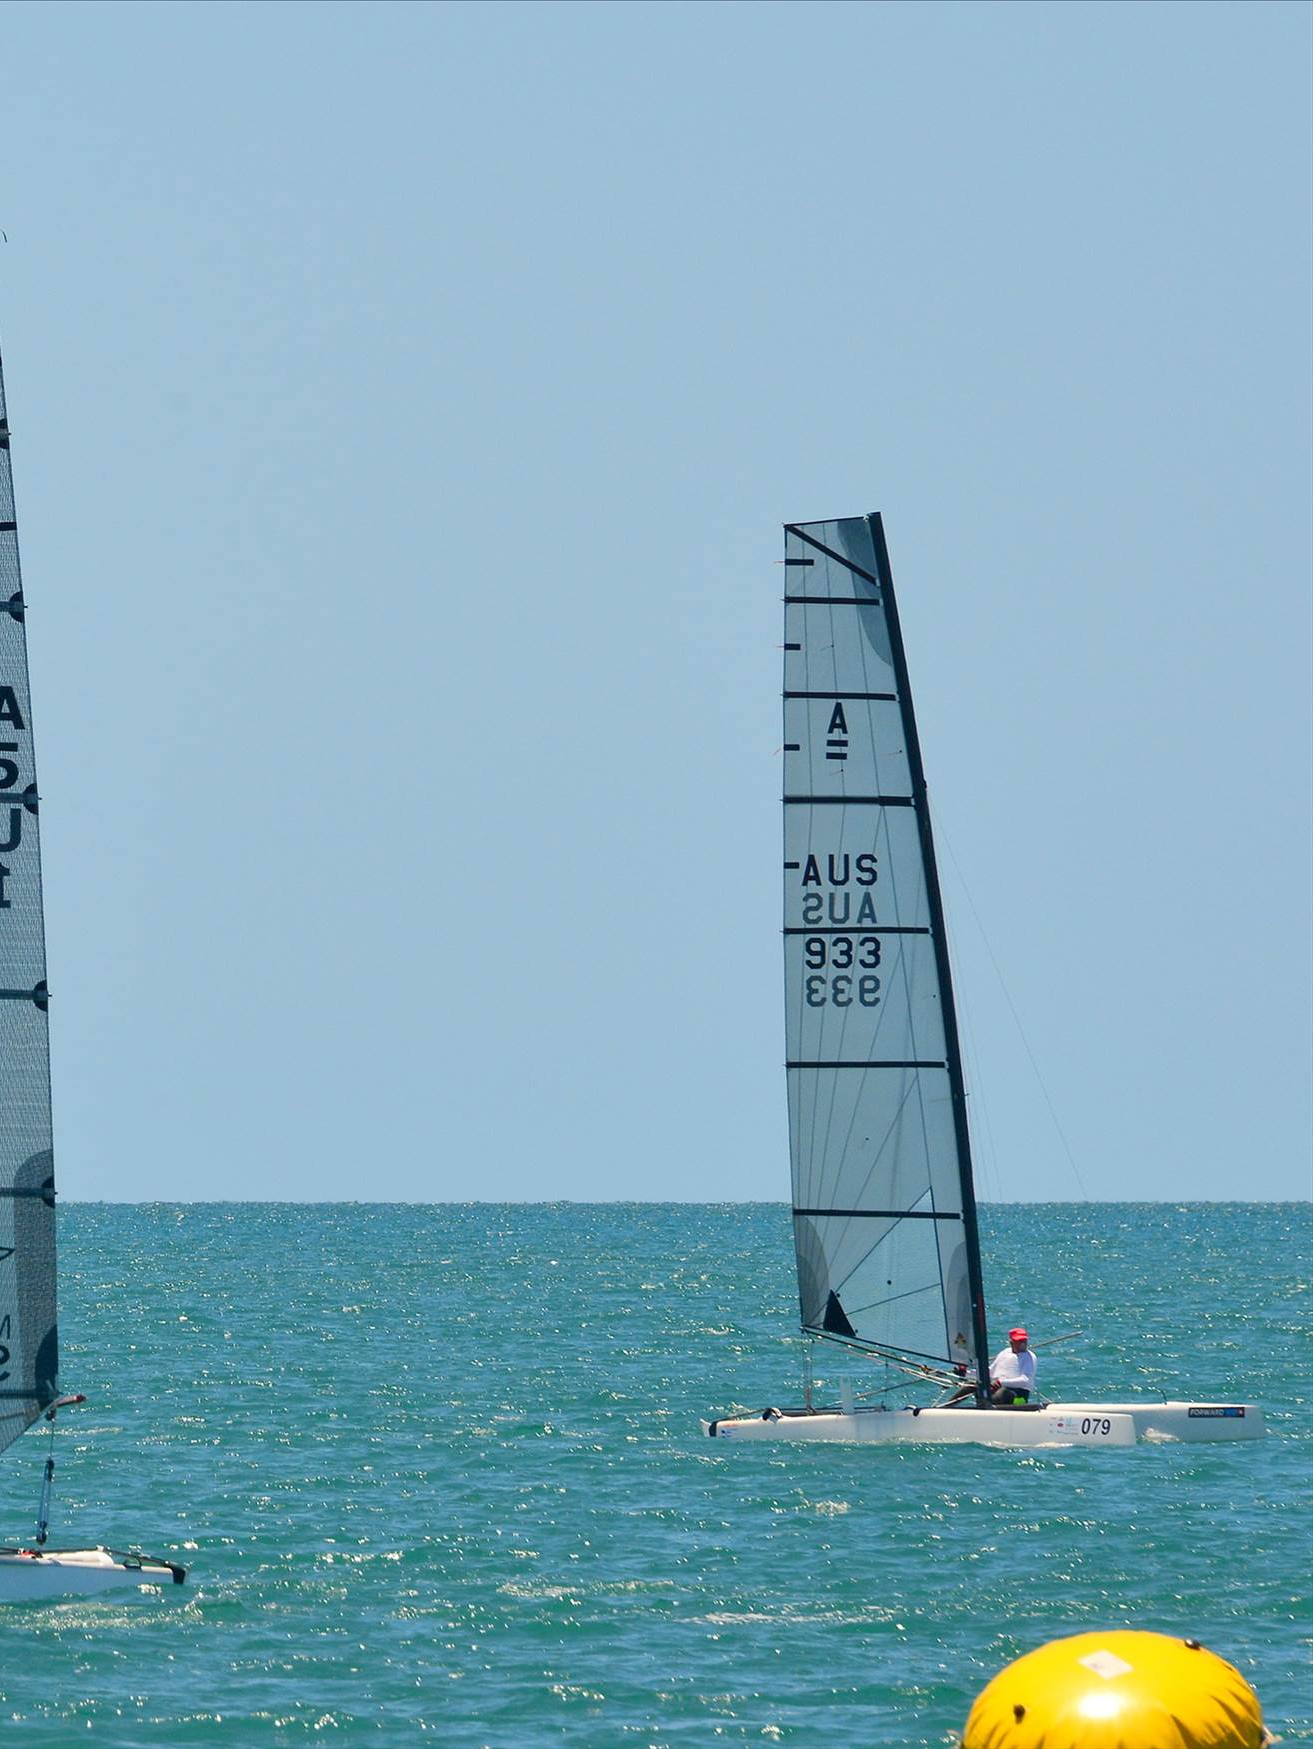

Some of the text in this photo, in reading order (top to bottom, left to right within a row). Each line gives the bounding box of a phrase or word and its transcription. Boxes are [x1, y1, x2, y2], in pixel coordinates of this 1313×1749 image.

[827, 702, 848, 734] A
[801, 853, 878, 887] AUS
[805, 937, 881, 970] 933
[1081, 1418, 1111, 1435] 079
